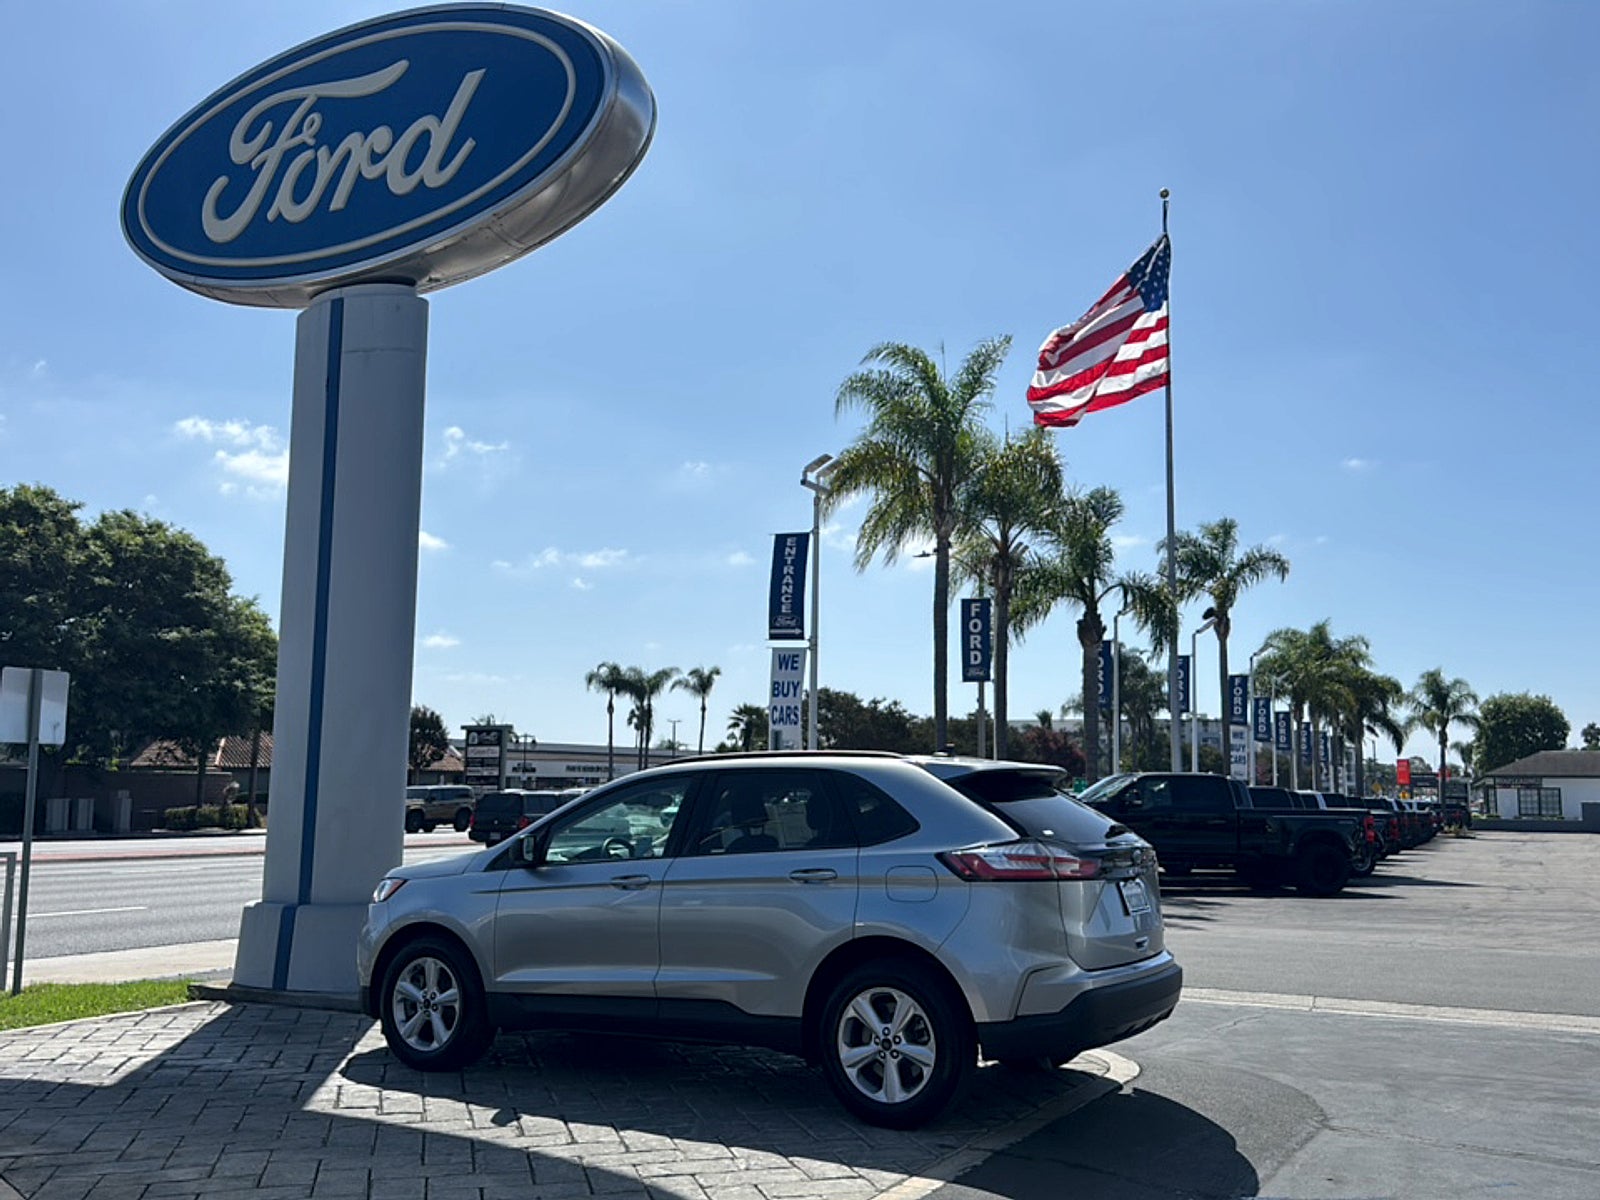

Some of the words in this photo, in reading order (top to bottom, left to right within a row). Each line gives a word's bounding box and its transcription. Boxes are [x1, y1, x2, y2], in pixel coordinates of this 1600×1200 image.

[202, 59, 486, 243] Ford
[781, 536, 797, 613] ENTRANCE
[968, 602, 983, 665] FORD
[778, 653, 800, 671] WE
[772, 681, 800, 698] BUY
[1233, 677, 1243, 715] FORD
[771, 705, 800, 725] CARS
